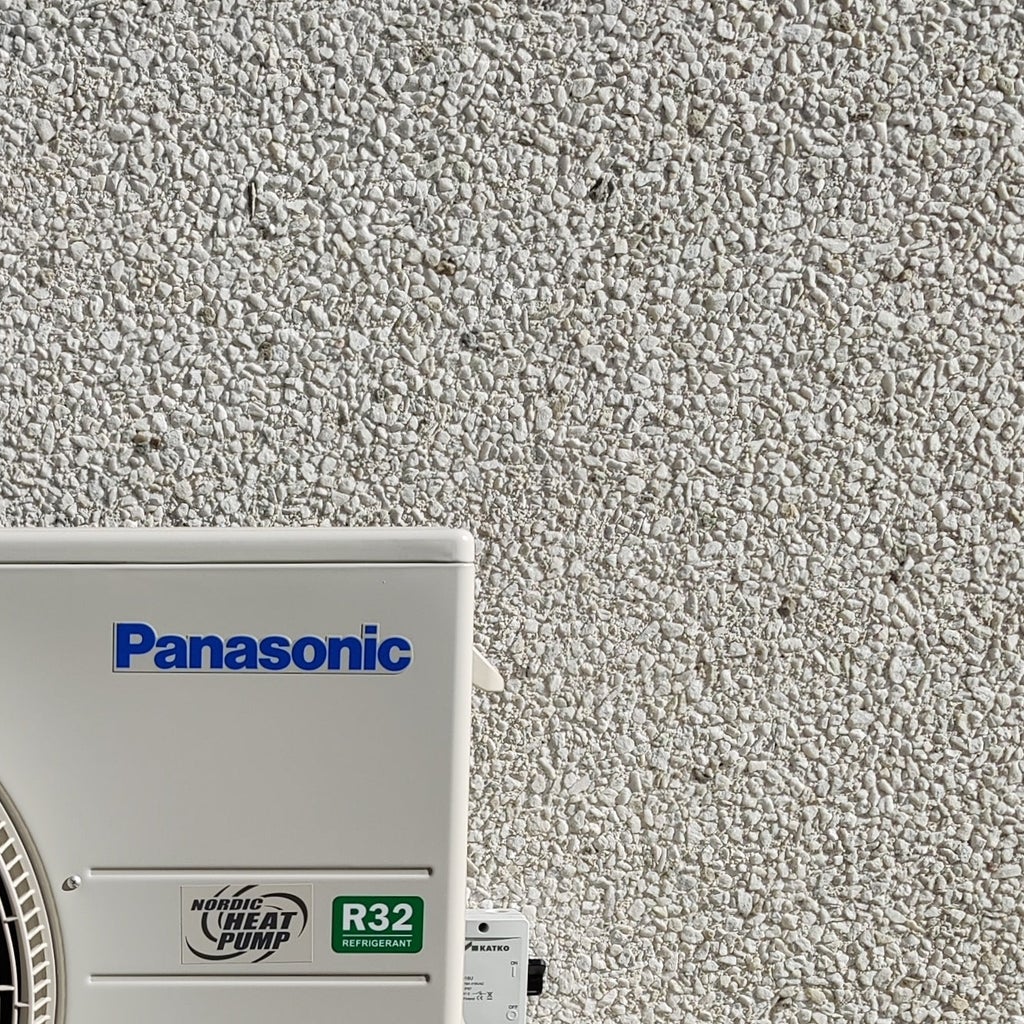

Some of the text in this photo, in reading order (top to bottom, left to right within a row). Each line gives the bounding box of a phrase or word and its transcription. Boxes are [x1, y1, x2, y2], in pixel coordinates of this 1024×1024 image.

[115, 622, 413, 672] Panasonic
[190, 898, 264, 911] NORDIC
[222, 911, 298, 931] HEAT
[342, 902, 414, 931] R32
[216, 931, 292, 951] PUMP
[342, 939, 413, 948] REFRIGERANT
